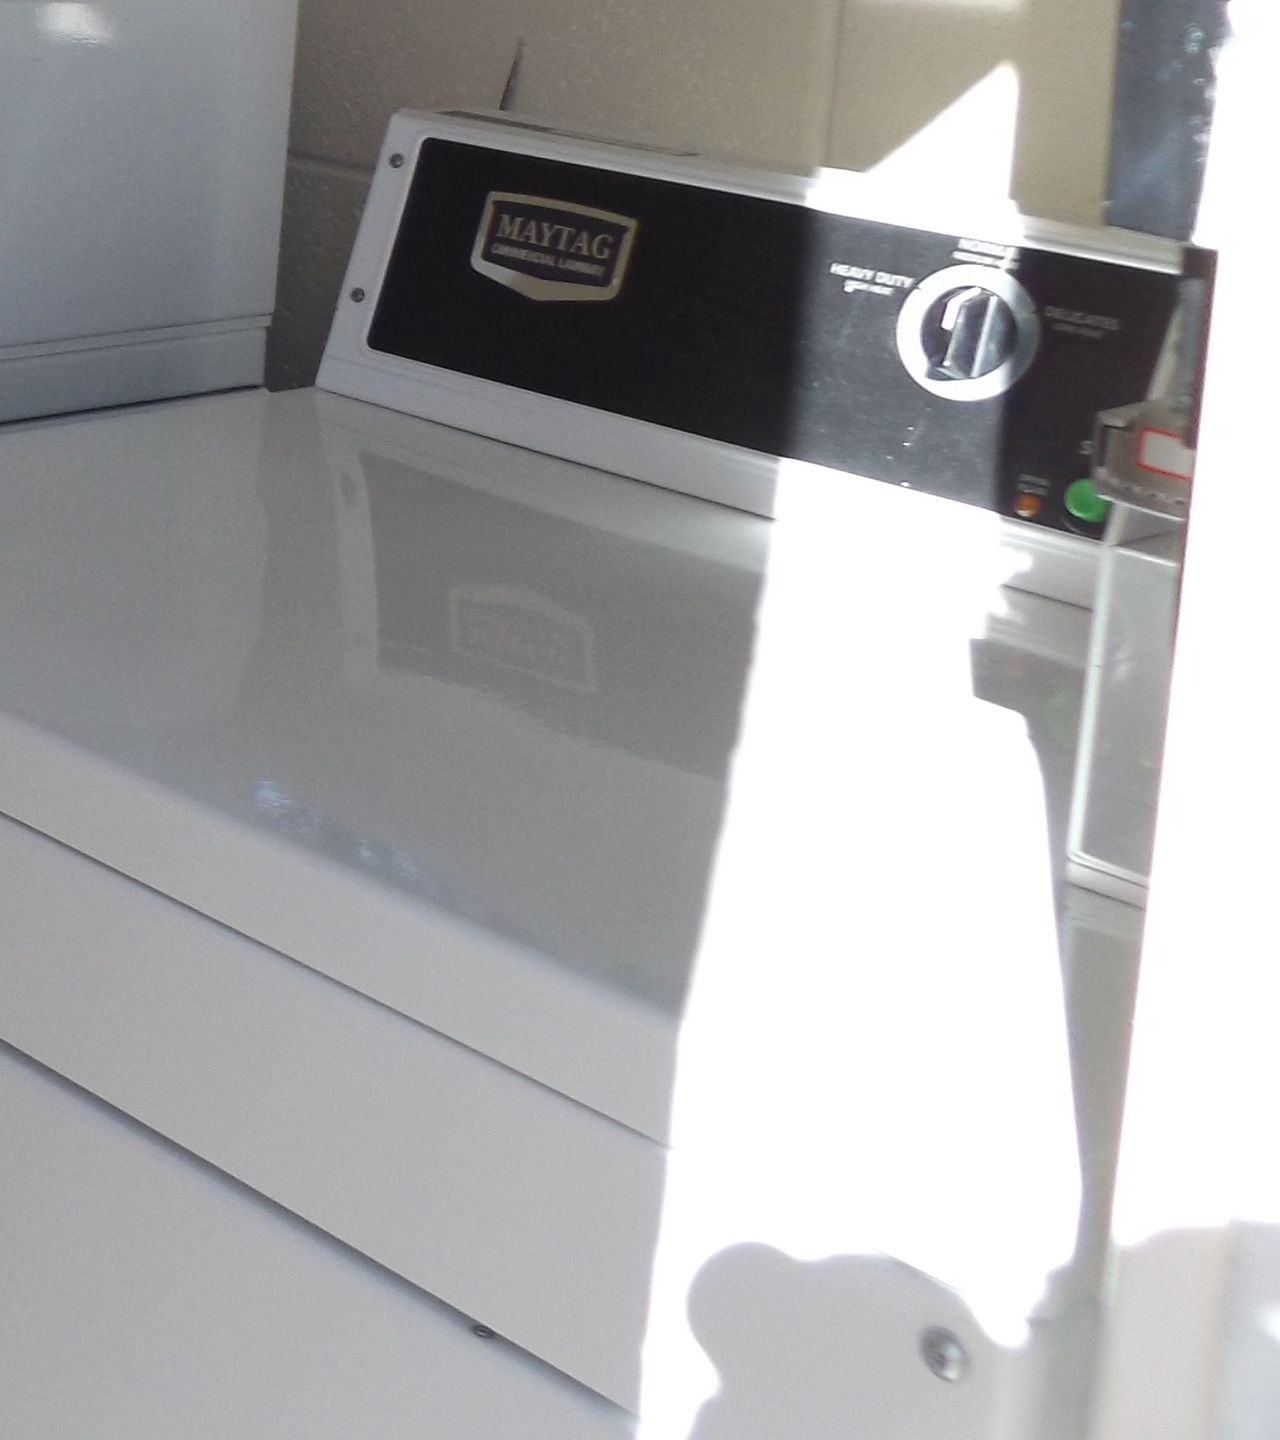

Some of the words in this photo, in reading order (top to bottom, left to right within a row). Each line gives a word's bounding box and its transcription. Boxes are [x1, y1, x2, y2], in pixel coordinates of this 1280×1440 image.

[496, 214, 612, 259] MAYTAG
[829, 262, 874, 283] HEAVY
[874, 271, 916, 288] DUTY
